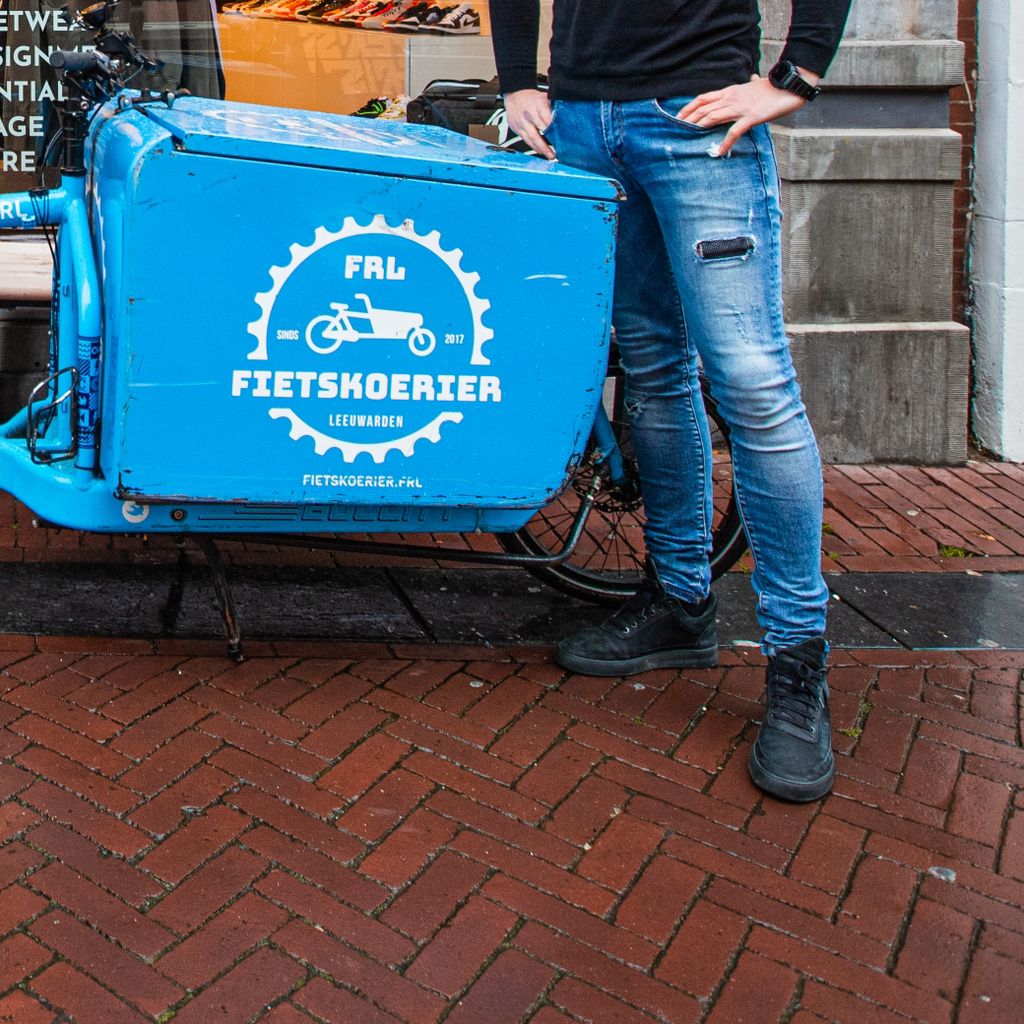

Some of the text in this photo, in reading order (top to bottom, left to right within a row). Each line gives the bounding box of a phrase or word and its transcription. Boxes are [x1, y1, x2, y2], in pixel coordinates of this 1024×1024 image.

[344, 255, 406, 281] FRL
[276, 329, 465, 345] SINDS 2017
[231, 369, 502, 403] FIETSKOERIER
[329, 414, 403, 428] LEEUWARDEN
[302, 474, 423, 489] FIETSKOERIER.FRL
